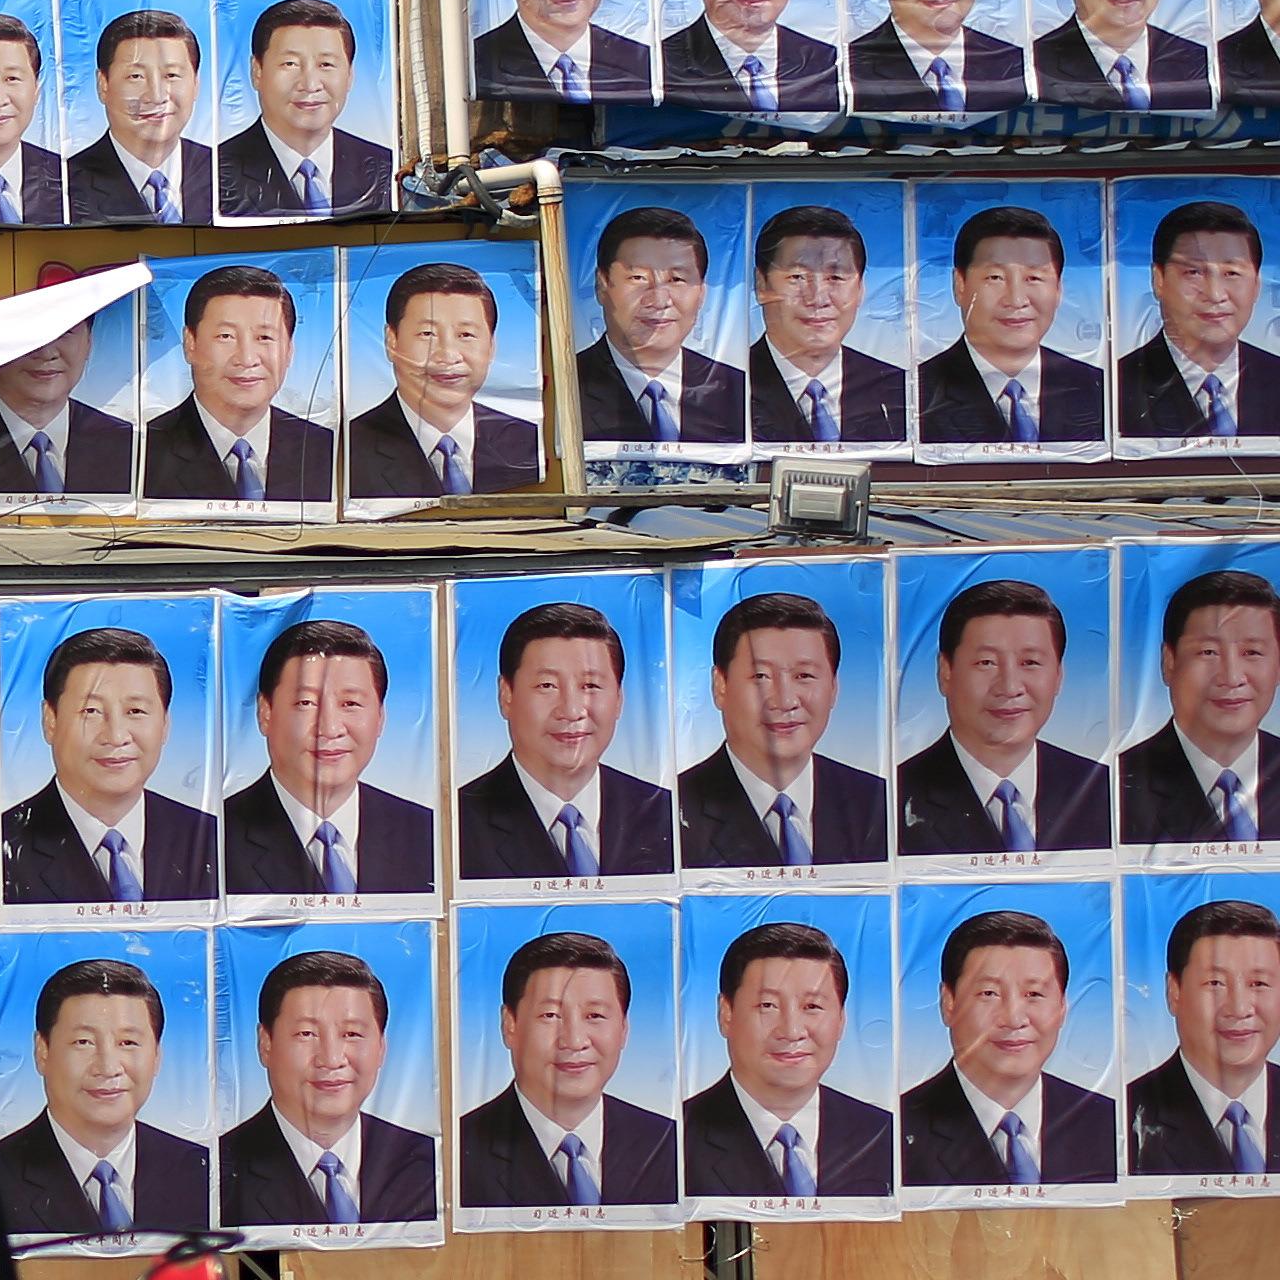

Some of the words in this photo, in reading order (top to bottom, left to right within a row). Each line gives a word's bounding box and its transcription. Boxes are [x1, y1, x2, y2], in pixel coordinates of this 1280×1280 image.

[910, 111, 969, 123] 习近平同志
[621, 442, 685, 453] 习近平同志
[782, 443, 846, 454] 习近平同志
[982, 442, 1045, 455] 习近平同志
[206, 500, 270, 513] 习近平同志
[1192, 841, 1265, 857] 习近平同志
[969, 852, 1042, 868] 习近平同志
[746, 866, 819, 881] 习近平同志
[533, 877, 606, 891] 习近平同志
[288, 895, 363, 908] 习近平同志
[76, 902, 149, 917] 习近平同志
[1199, 1174, 1272, 1188] 习近平同志
[974, 1184, 1047, 1199] 习近平同志
[748, 1197, 823, 1211] 习近平同志
[532, 1206, 607, 1220] 习近平同志
[292, 1224, 367, 1238] 习近平同志
